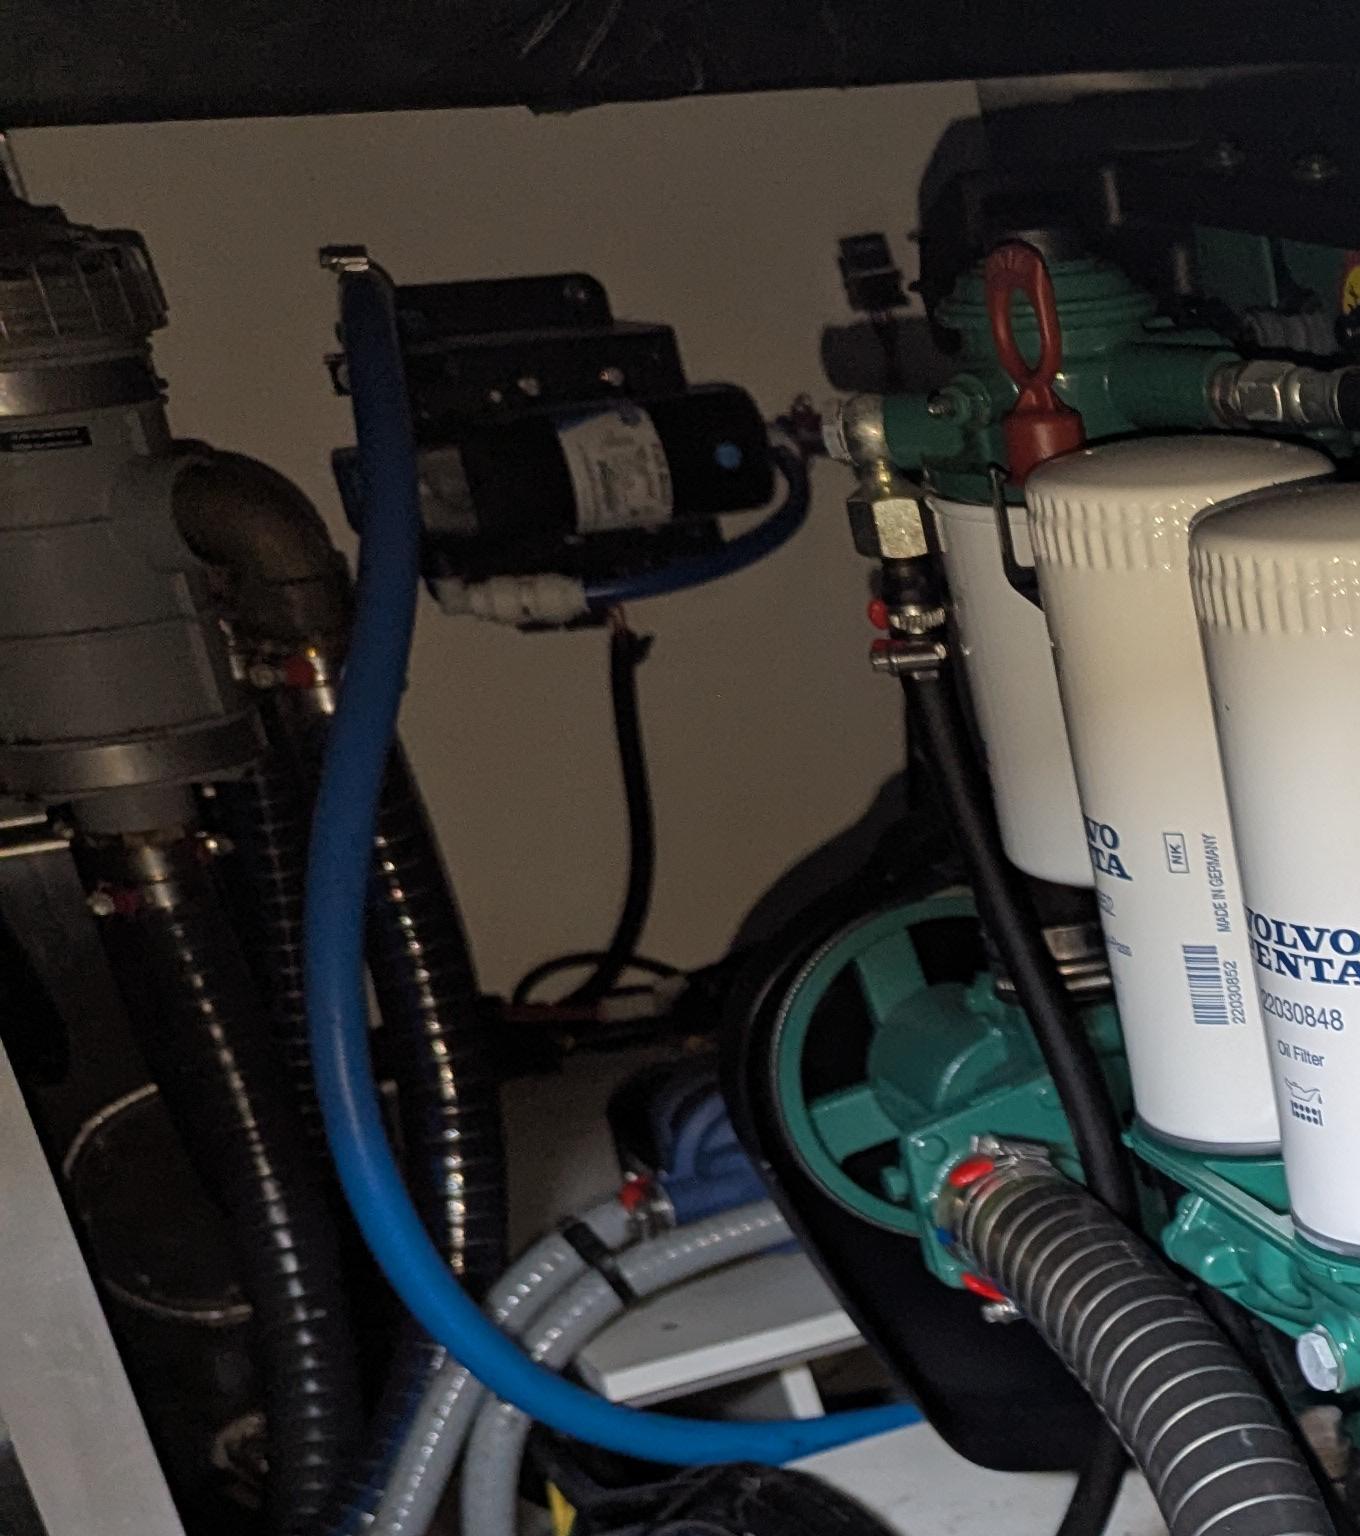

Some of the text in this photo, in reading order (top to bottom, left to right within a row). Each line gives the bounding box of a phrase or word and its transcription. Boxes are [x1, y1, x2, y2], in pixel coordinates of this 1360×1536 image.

[1168, 842, 1185, 866] NK
[1202, 833, 1232, 933] MADE IN GERMANY
[1223, 960, 1246, 1025] 22030852
[1277, 1039, 1325, 1067] Oil Filter
